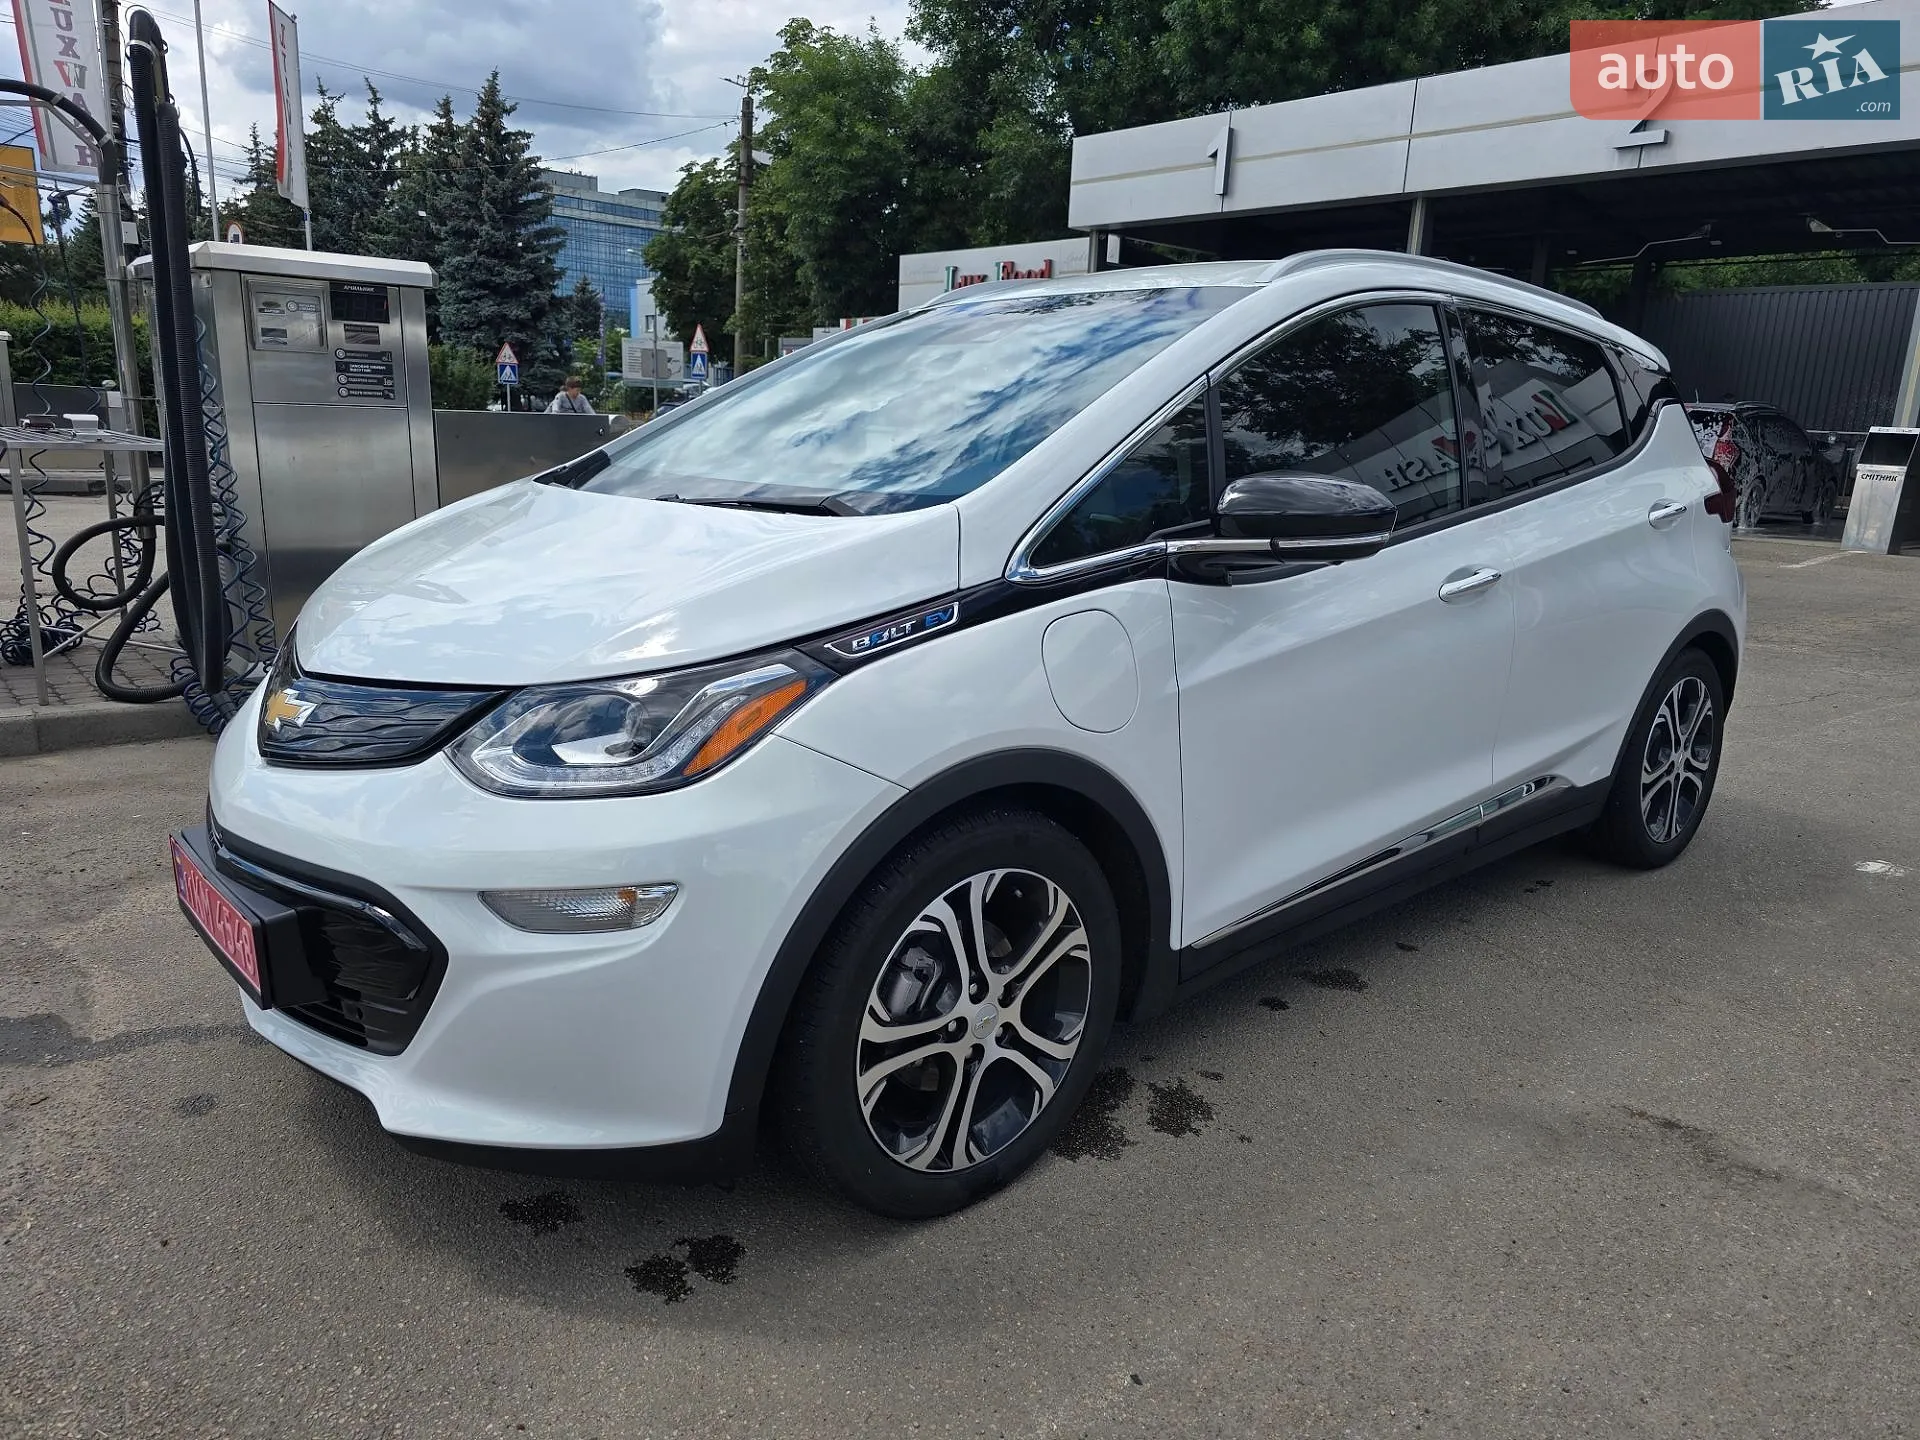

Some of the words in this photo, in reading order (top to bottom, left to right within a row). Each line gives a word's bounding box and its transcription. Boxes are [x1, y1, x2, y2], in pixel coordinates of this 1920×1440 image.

[1206, 126, 1234, 196] 1
[1860, 473, 1898, 482] СМІТНИК
[852, 620, 917, 652] BOLT
[924, 608, 953, 628] EV
